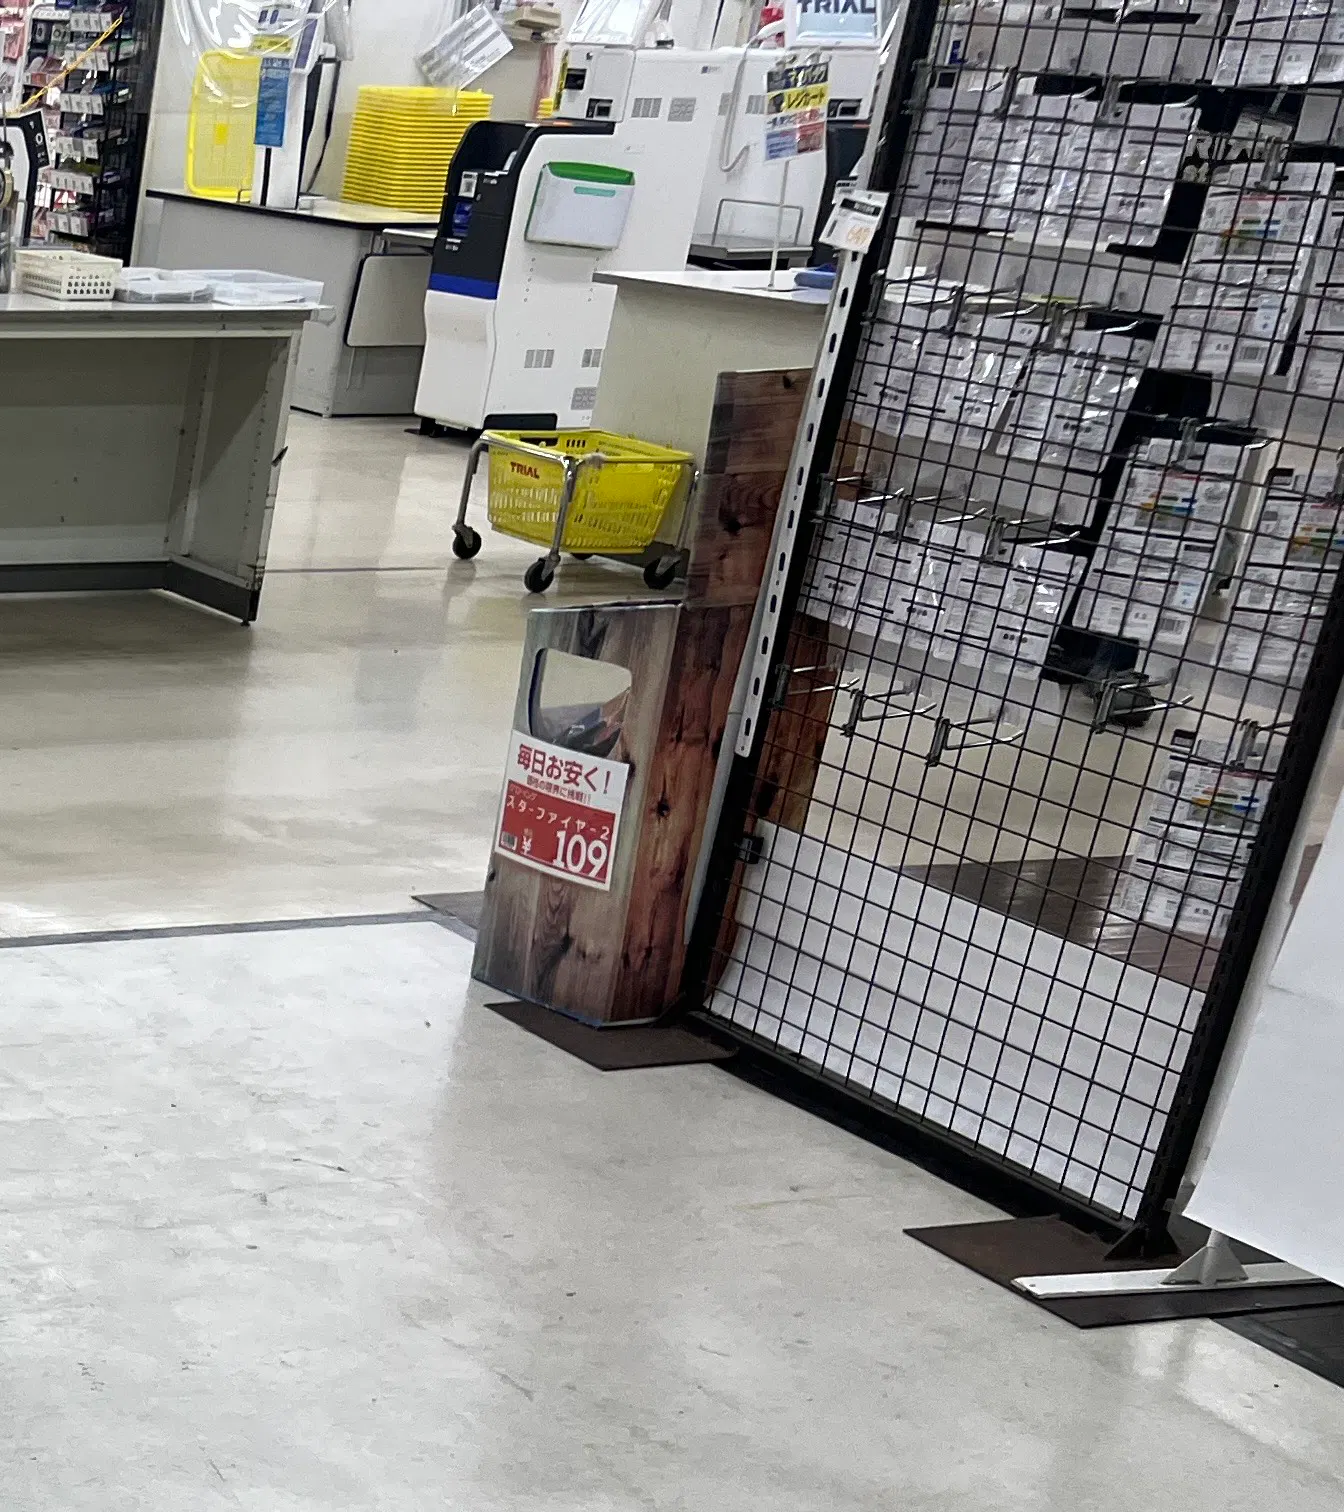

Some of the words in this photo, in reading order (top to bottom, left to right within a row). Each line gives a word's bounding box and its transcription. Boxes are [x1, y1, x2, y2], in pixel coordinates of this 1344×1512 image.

[798, 0, 876, 14] TRIAL
[510, 461, 540, 479] TRIAL
[552, 830, 608, 878] 109
